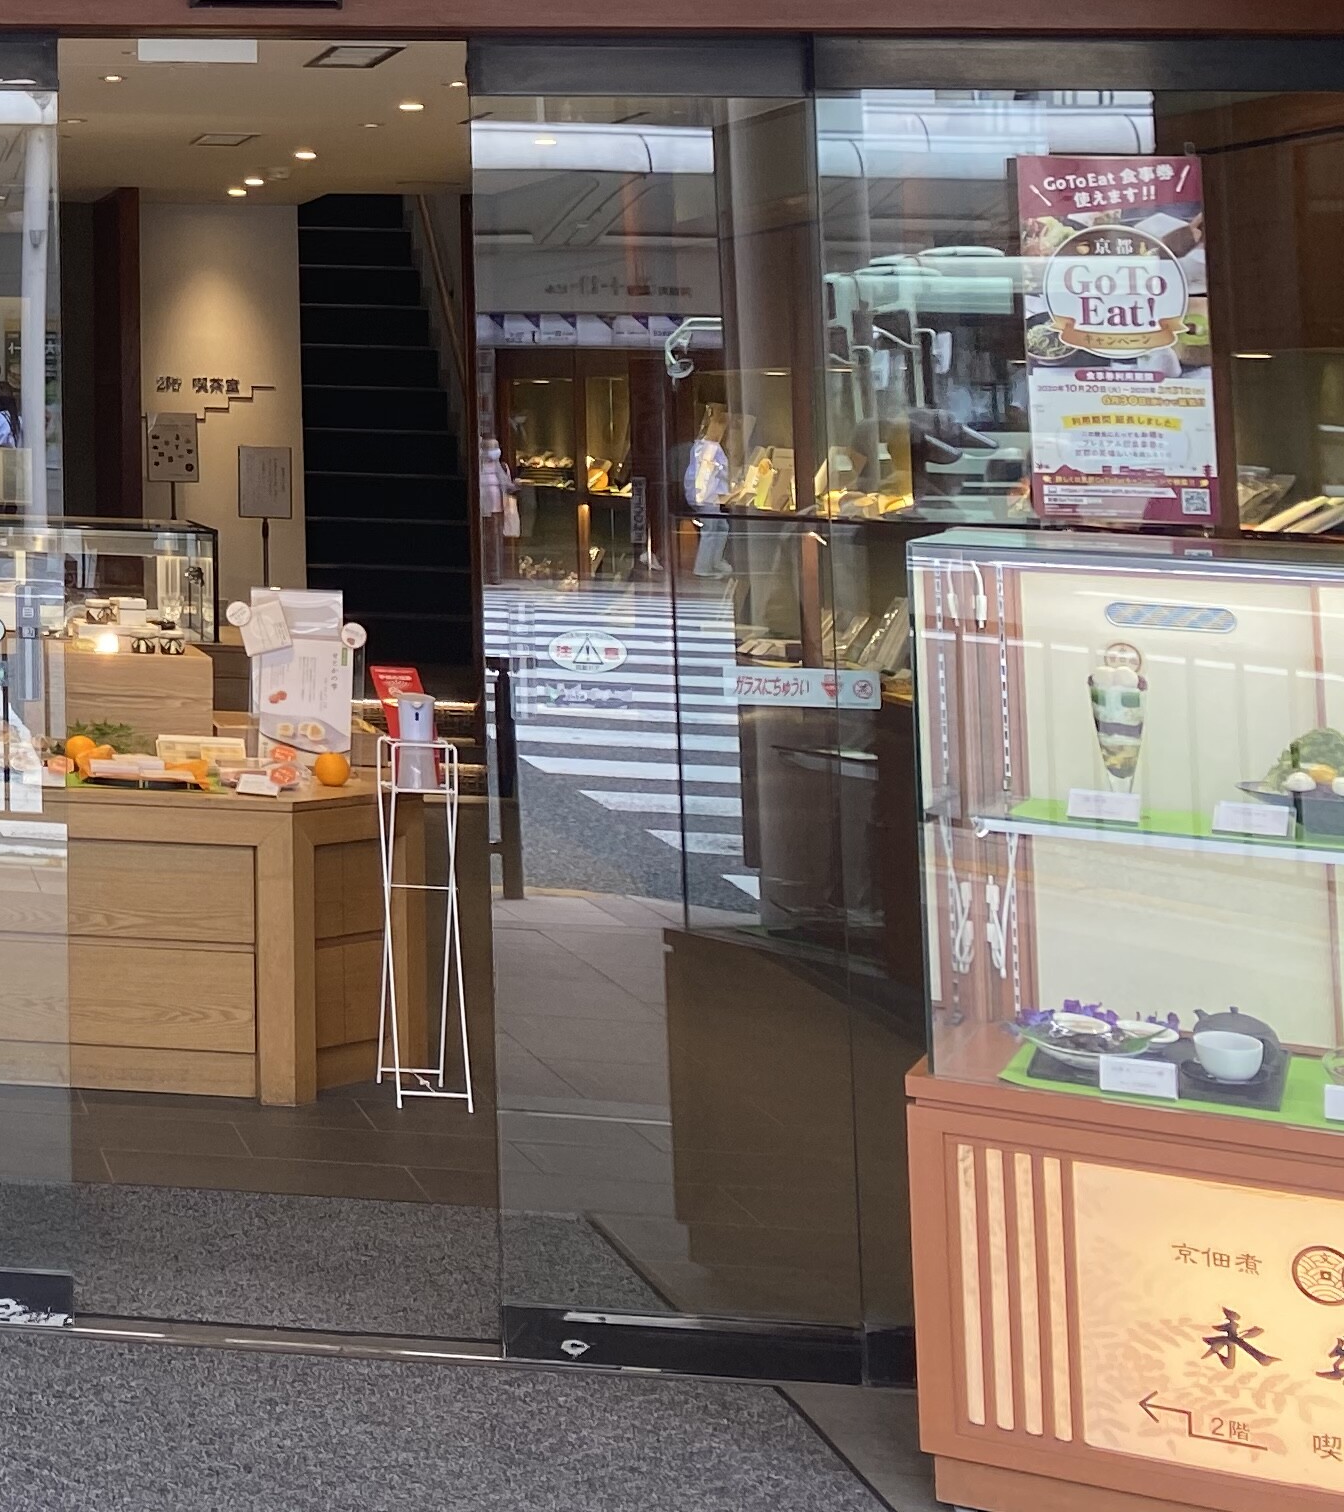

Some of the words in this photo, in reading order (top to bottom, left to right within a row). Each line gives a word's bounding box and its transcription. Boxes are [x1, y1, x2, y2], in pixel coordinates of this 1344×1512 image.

[1043, 174, 1116, 191] GoToEat
[1094, 238, 1134, 254] 京都
[1079, 297, 1157, 327] Eat!
[733, 675, 810, 695] ガラスにちゅうい
[1172, 1243, 1263, 1276] 京佃煮
[1211, 1417, 1250, 1442] 2階
